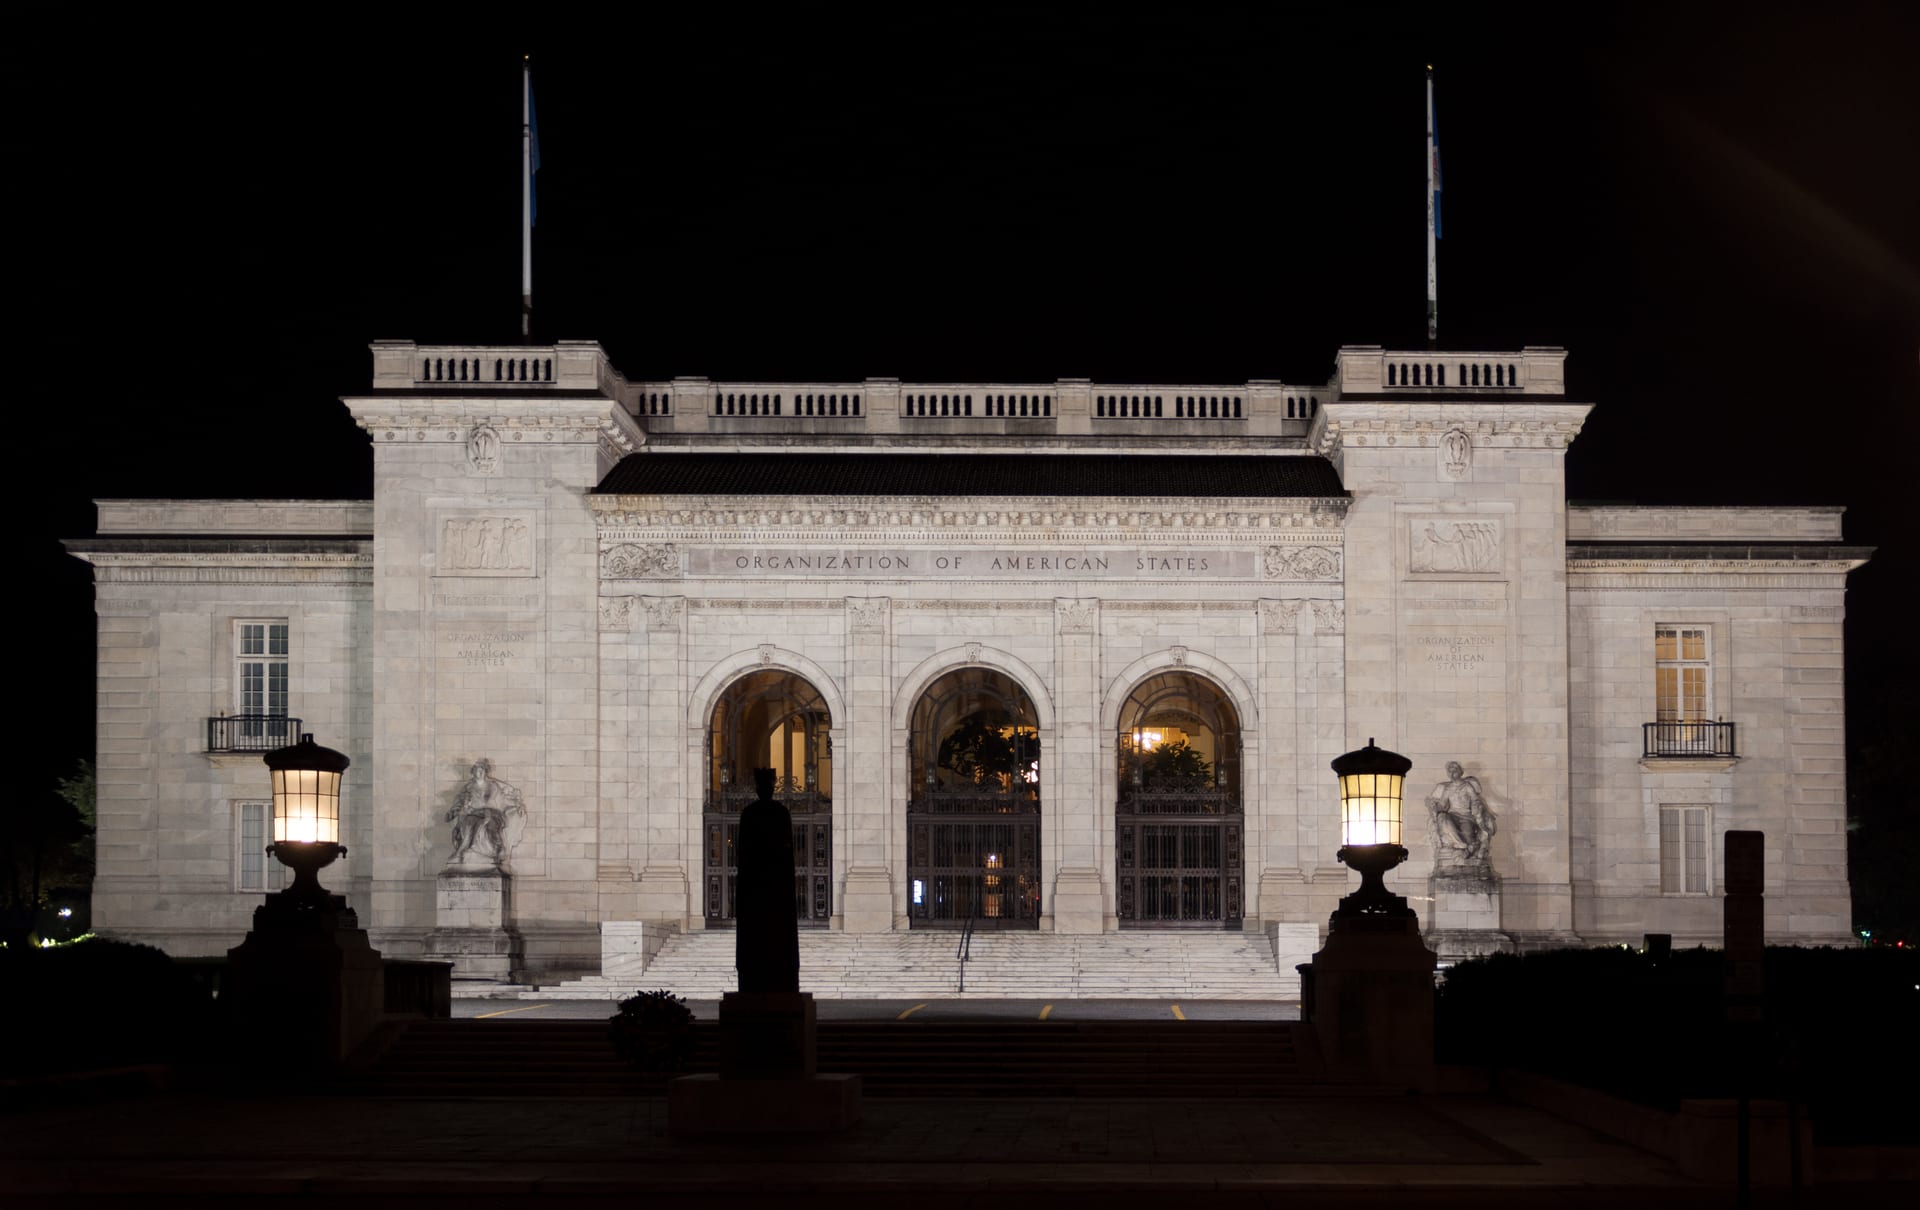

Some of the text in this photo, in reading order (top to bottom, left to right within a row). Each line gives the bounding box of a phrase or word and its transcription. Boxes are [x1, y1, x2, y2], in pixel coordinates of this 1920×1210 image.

[735, 556, 1209, 570] ORGANIZATION OF AMERICAN STATES
[1428, 654, 1484, 662] AMERICAN
